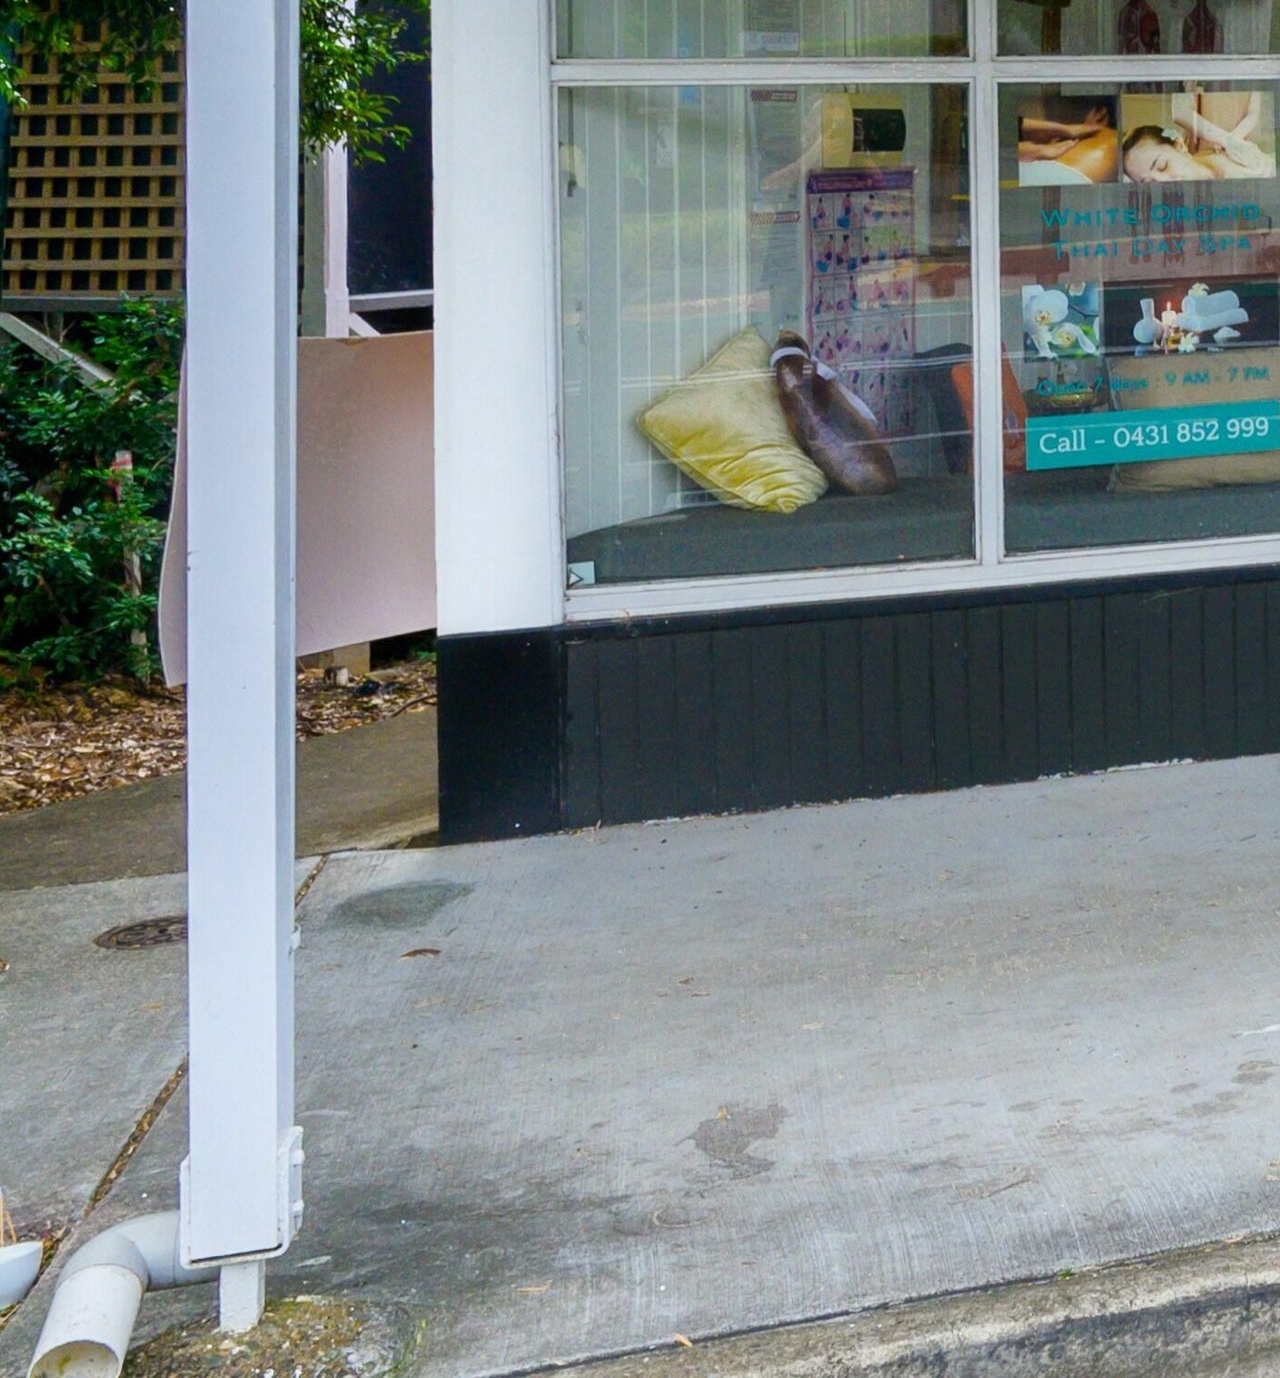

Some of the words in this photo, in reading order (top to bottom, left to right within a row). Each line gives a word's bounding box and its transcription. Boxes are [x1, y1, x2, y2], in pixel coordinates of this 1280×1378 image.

[1039, 428, 1087, 454] Call
[1113, 425, 1169, 448] 0431
[1176, 421, 1220, 443] 852
[1226, 416, 1270, 439] 999
